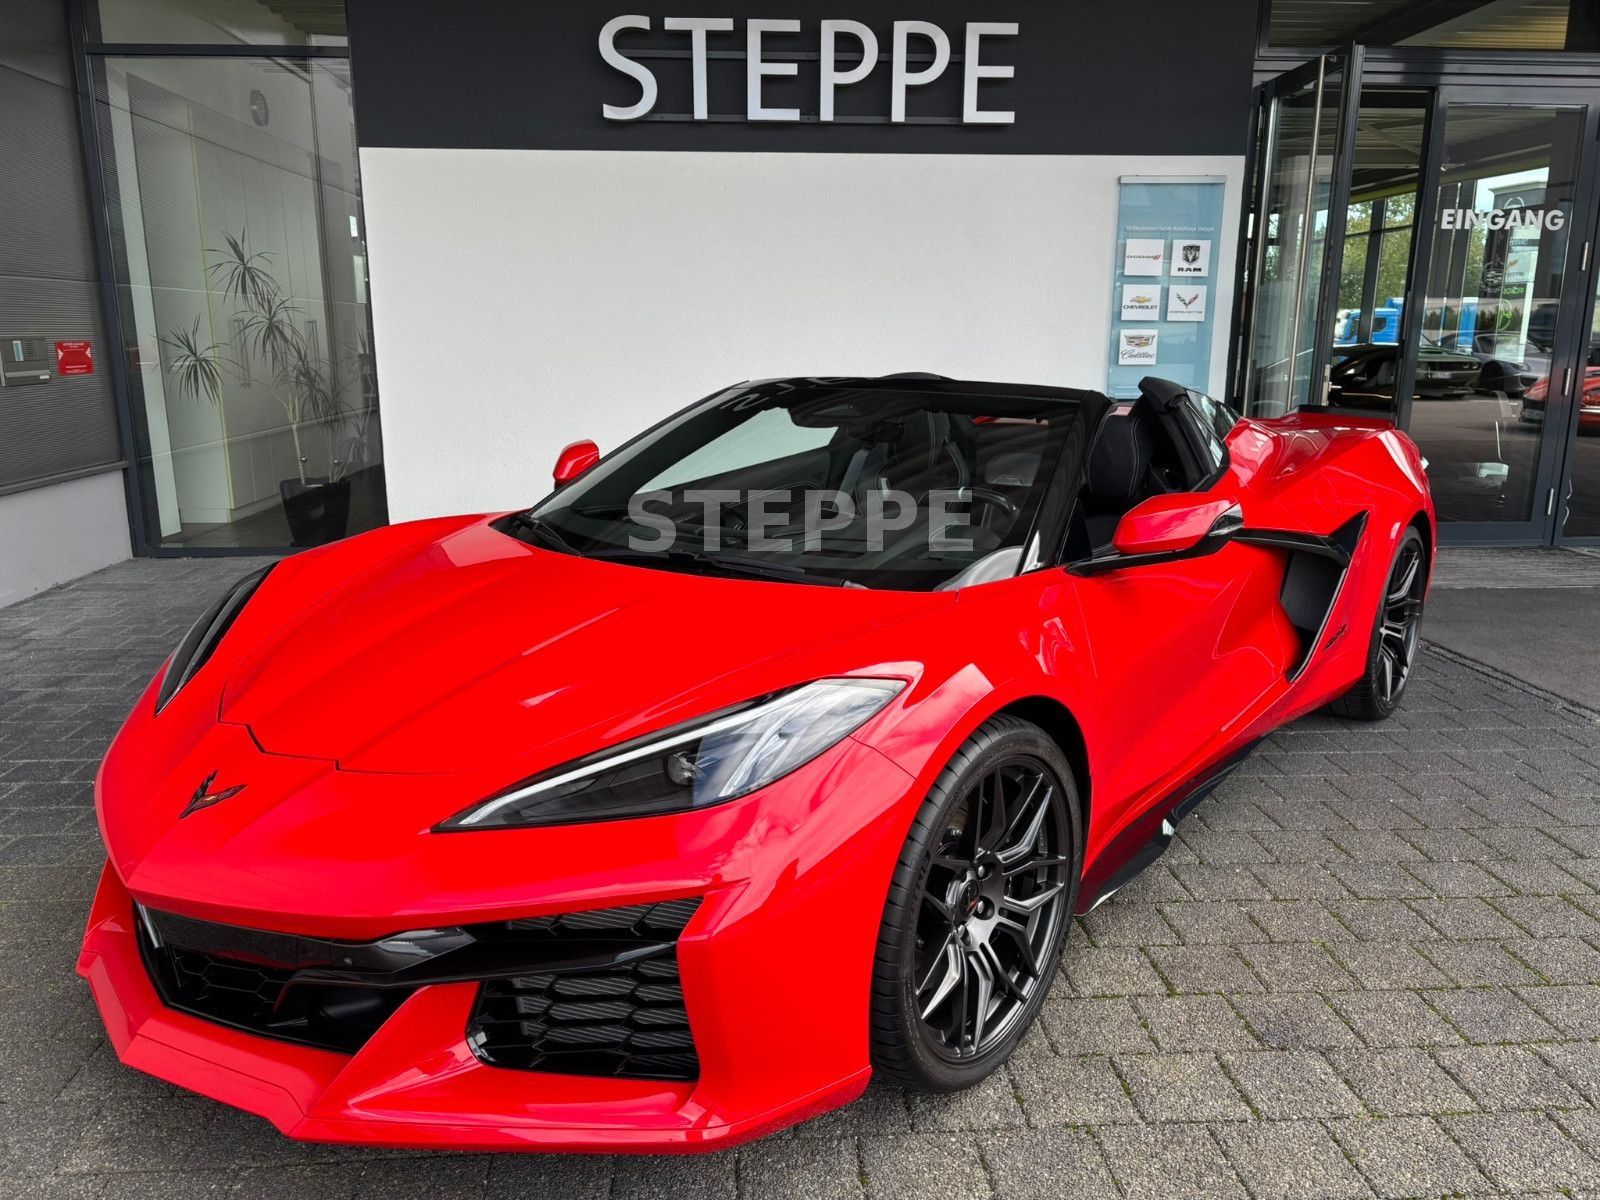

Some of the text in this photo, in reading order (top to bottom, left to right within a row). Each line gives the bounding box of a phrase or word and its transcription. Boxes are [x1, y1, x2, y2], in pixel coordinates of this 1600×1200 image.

[597, 14, 1020, 124] STEPPE
[1440, 208, 1565, 231] EINGANG
[1120, 349, 1155, 360] Cadillac
